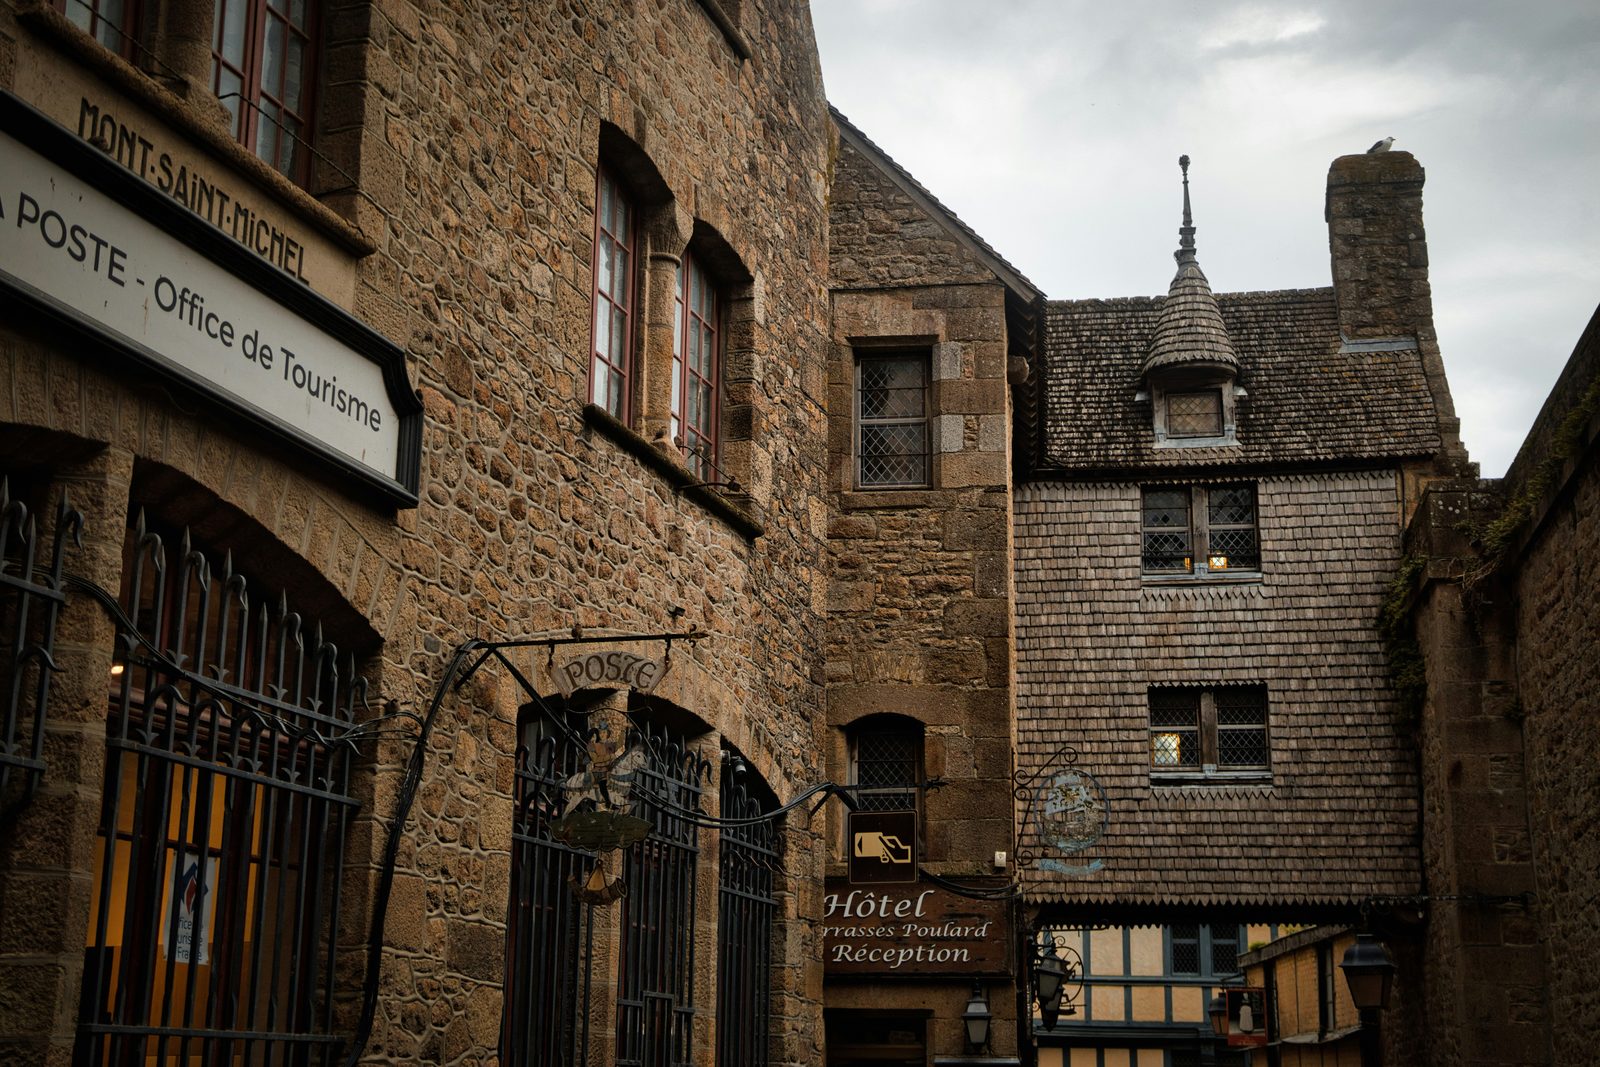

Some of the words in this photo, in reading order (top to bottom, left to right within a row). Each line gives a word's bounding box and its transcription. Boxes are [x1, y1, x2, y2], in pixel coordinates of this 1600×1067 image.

[17, 192, 128, 288] POSTE
[154, 276, 235, 348] Office
[242, 329, 274, 370] de
[280, 347, 382, 432] Tourisme
[563, 652, 657, 690] POSTE
[824, 890, 935, 918] Hôtel
[823, 926, 895, 938] rrasses
[902, 921, 992, 938] Poulard
[832, 943, 971, 969] Réception
